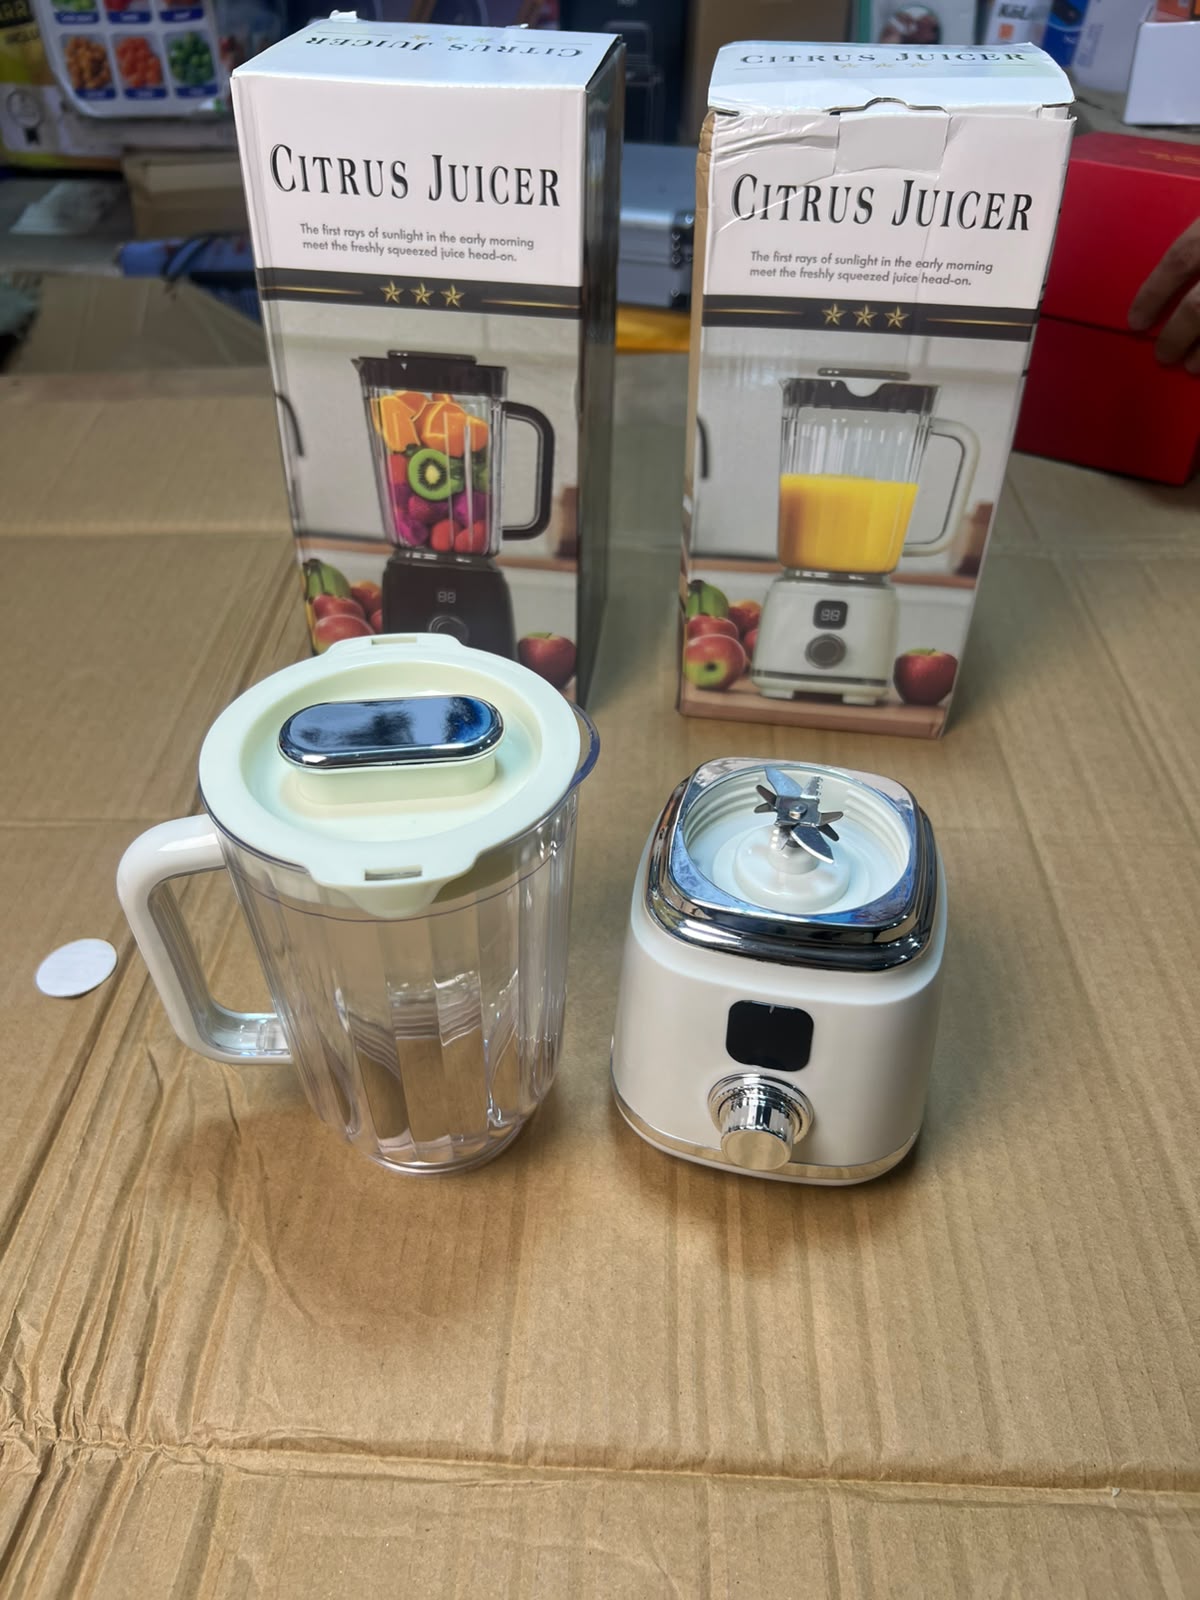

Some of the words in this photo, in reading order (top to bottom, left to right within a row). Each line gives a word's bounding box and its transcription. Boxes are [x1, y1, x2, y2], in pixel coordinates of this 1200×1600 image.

[305, 36, 433, 51] JUICER
[447, 43, 584, 58] CITRUS
[740, 53, 876, 64] CITRUS
[895, 52, 1026, 62] JUICER
[269, 143, 409, 199] CITRUS
[428, 154, 560, 207] JUICER
[731, 173, 875, 225] CITRUS
[891, 179, 1033, 231] JUICER
[300, 223, 319, 235] The
[322, 224, 341, 237] first
[343, 227, 365, 240] rays
[368, 226, 379, 239] of
[382, 228, 424, 244] sunlight
[426, 231, 437, 242] in
[439, 231, 457, 244] the
[459, 233, 487, 247] early
[489, 235, 534, 250] morning
[302, 240, 329, 251] meet
[331, 240, 349, 252] the
[351, 240, 385, 256] freshly
[387, 244, 438, 258] squeezed
[440, 246, 465, 261] juice
[468, 248, 517, 262] head-on.
[750, 250, 769, 262] The
[773, 251, 792, 263] first
[795, 254, 817, 266] rays
[820, 252, 833, 264] of
[835, 253, 878, 269] sunlight
[881, 256, 892, 267] in
[894, 256, 912, 268] the
[915, 257, 943, 271] early
[946, 260, 993, 274] morning
[749, 266, 777, 278] meet
[779, 266, 797, 278] the
[799, 267, 835, 282] freshly
[837, 269, 890, 284] squeezed
[892, 271, 918, 286] juice
[921, 273, 972, 286] head-on.
